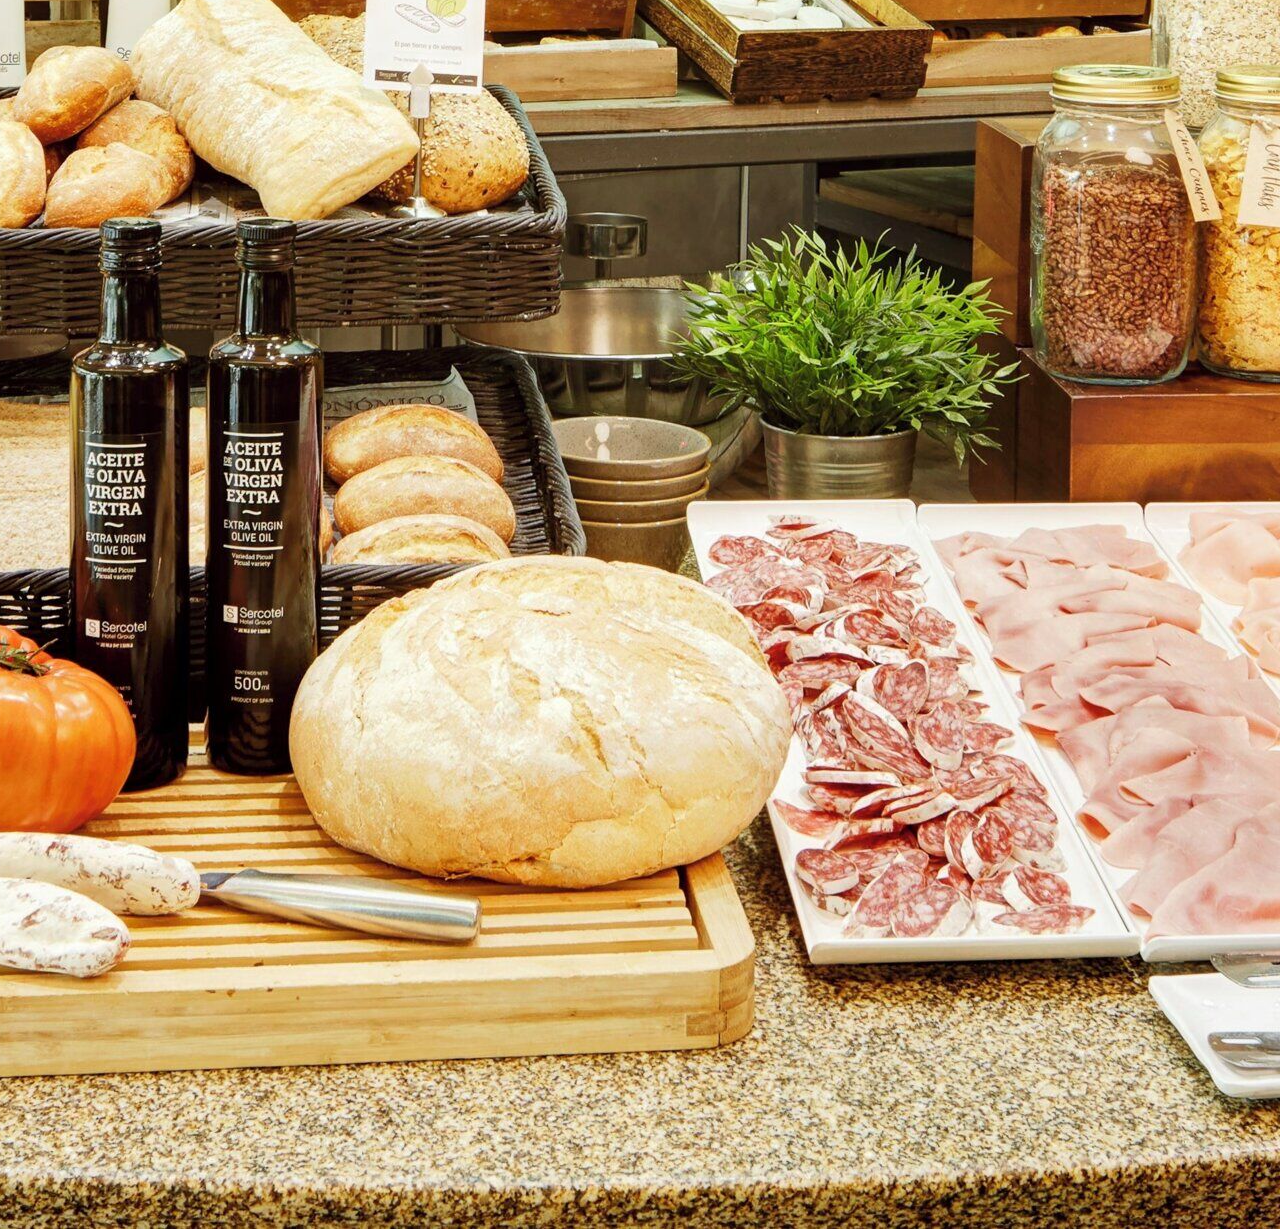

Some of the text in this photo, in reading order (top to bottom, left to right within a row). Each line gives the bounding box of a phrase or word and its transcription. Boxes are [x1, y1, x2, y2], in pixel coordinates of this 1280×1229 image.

[225, 441, 282, 456] ACEITE
[87, 452, 145, 467] ACEITE
[235, 458, 283, 472] OLIVA
[96, 470, 146, 483] OLIVA
[224, 472, 283, 488] VIRGEN
[86, 484, 146, 500] VIRGEN
[226, 489, 280, 504] EXTRA
[88, 500, 143, 516] EXTRA
[223, 519, 283, 531] EXTRA VIRGIN
[86, 531, 146, 543] EXTRA VIRGIN
[231, 531, 274, 542] OLIVE OIL
[93, 544, 137, 556] OLIVE OIL
[234, 559, 250, 567] Picual
[239, 607, 284, 619] Sercotel
[101, 620, 147, 633] Sercotel
